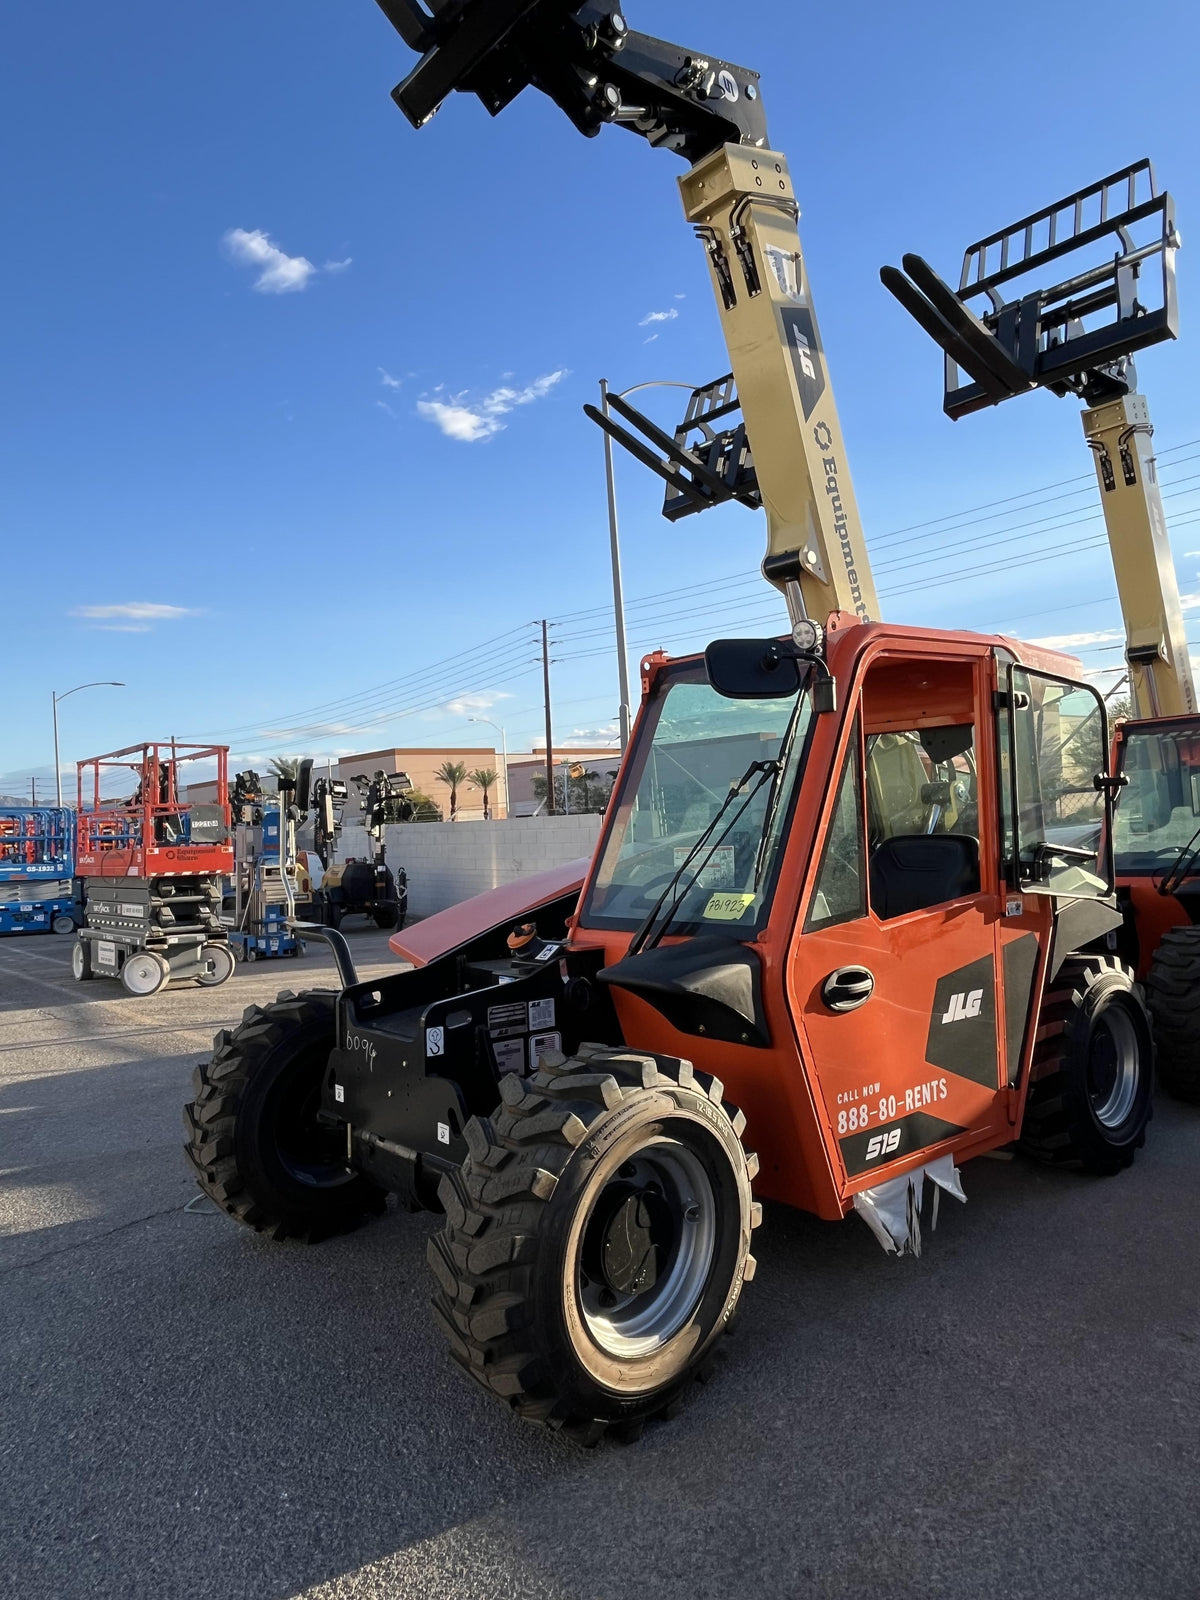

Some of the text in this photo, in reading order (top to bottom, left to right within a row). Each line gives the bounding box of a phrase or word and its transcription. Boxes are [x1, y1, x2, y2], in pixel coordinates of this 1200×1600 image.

[792, 323, 816, 380] JLG
[941, 989, 984, 1024] JLG
[837, 1082, 881, 1105] CALL NOW
[837, 1077, 948, 1134] 888-80-RENTS
[865, 1128, 902, 1161] 519
